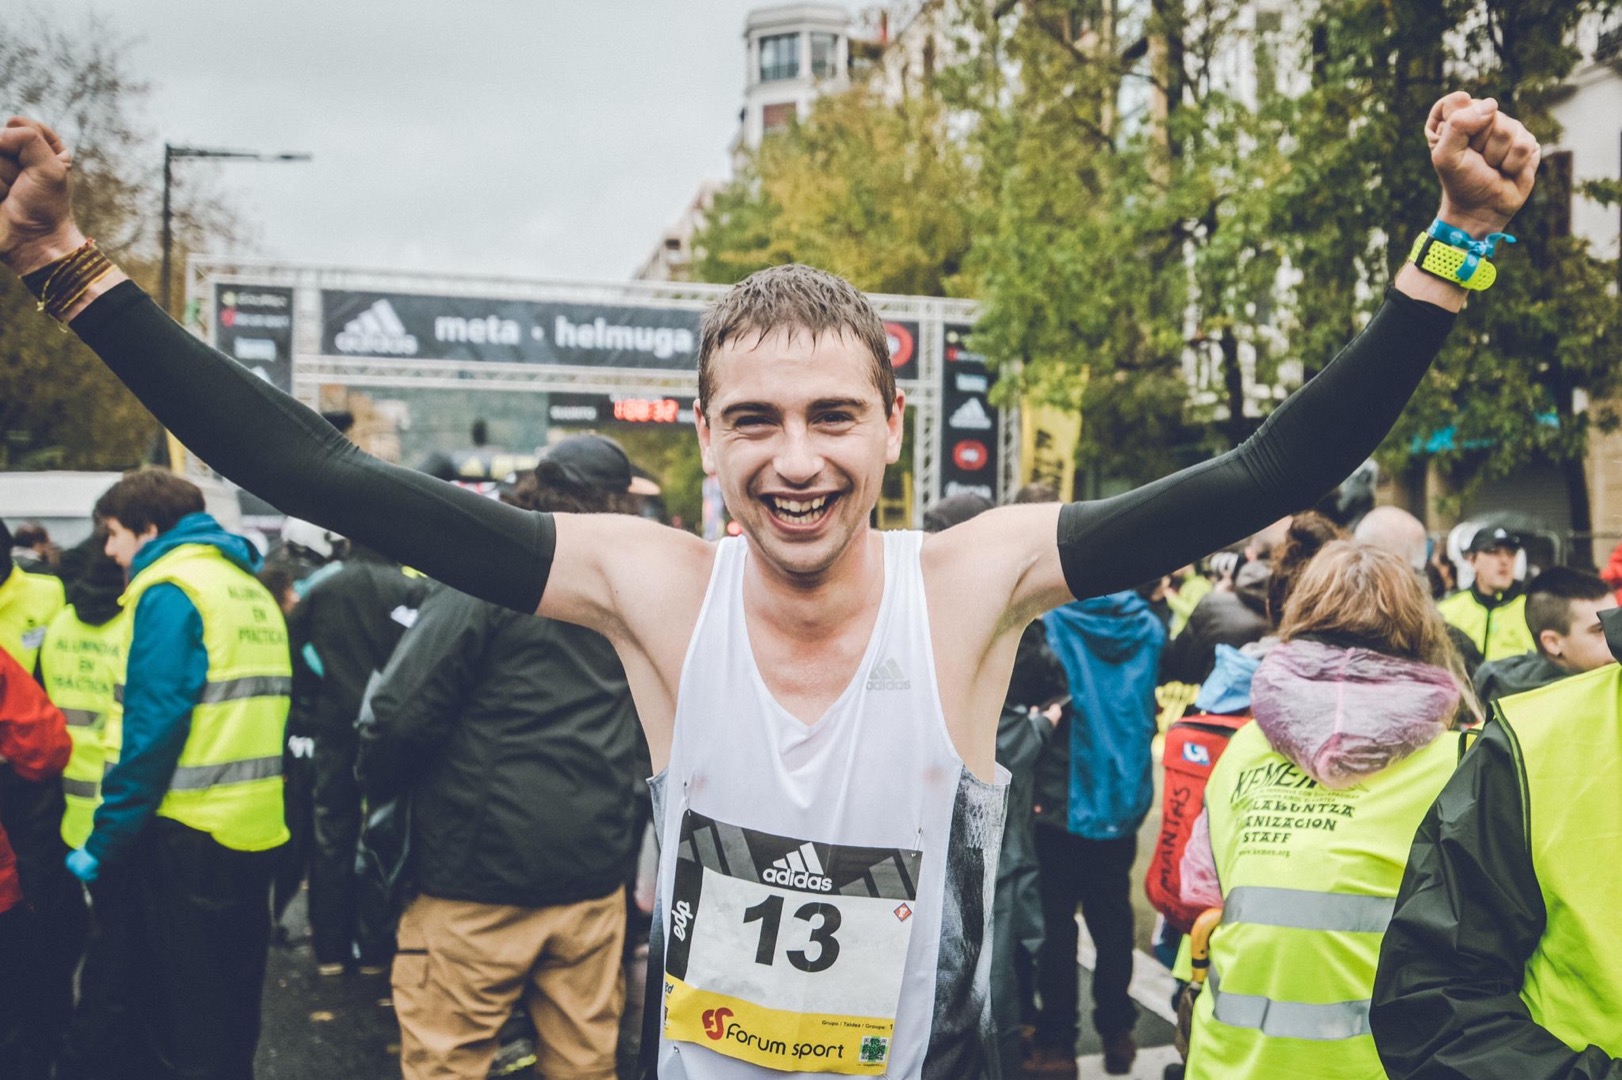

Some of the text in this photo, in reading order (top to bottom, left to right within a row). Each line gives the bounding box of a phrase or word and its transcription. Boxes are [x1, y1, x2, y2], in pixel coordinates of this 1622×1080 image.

[434, 314, 694, 358] meta helmuga
[79, 659, 94, 672] EN
[866, 679, 911, 691] adidas
[1243, 831, 1291, 843] STAFF
[763, 867, 832, 891] adidas
[671, 900, 693, 942] edp
[743, 894, 842, 973] 13
[726, 1023, 844, 1060] forum sport
